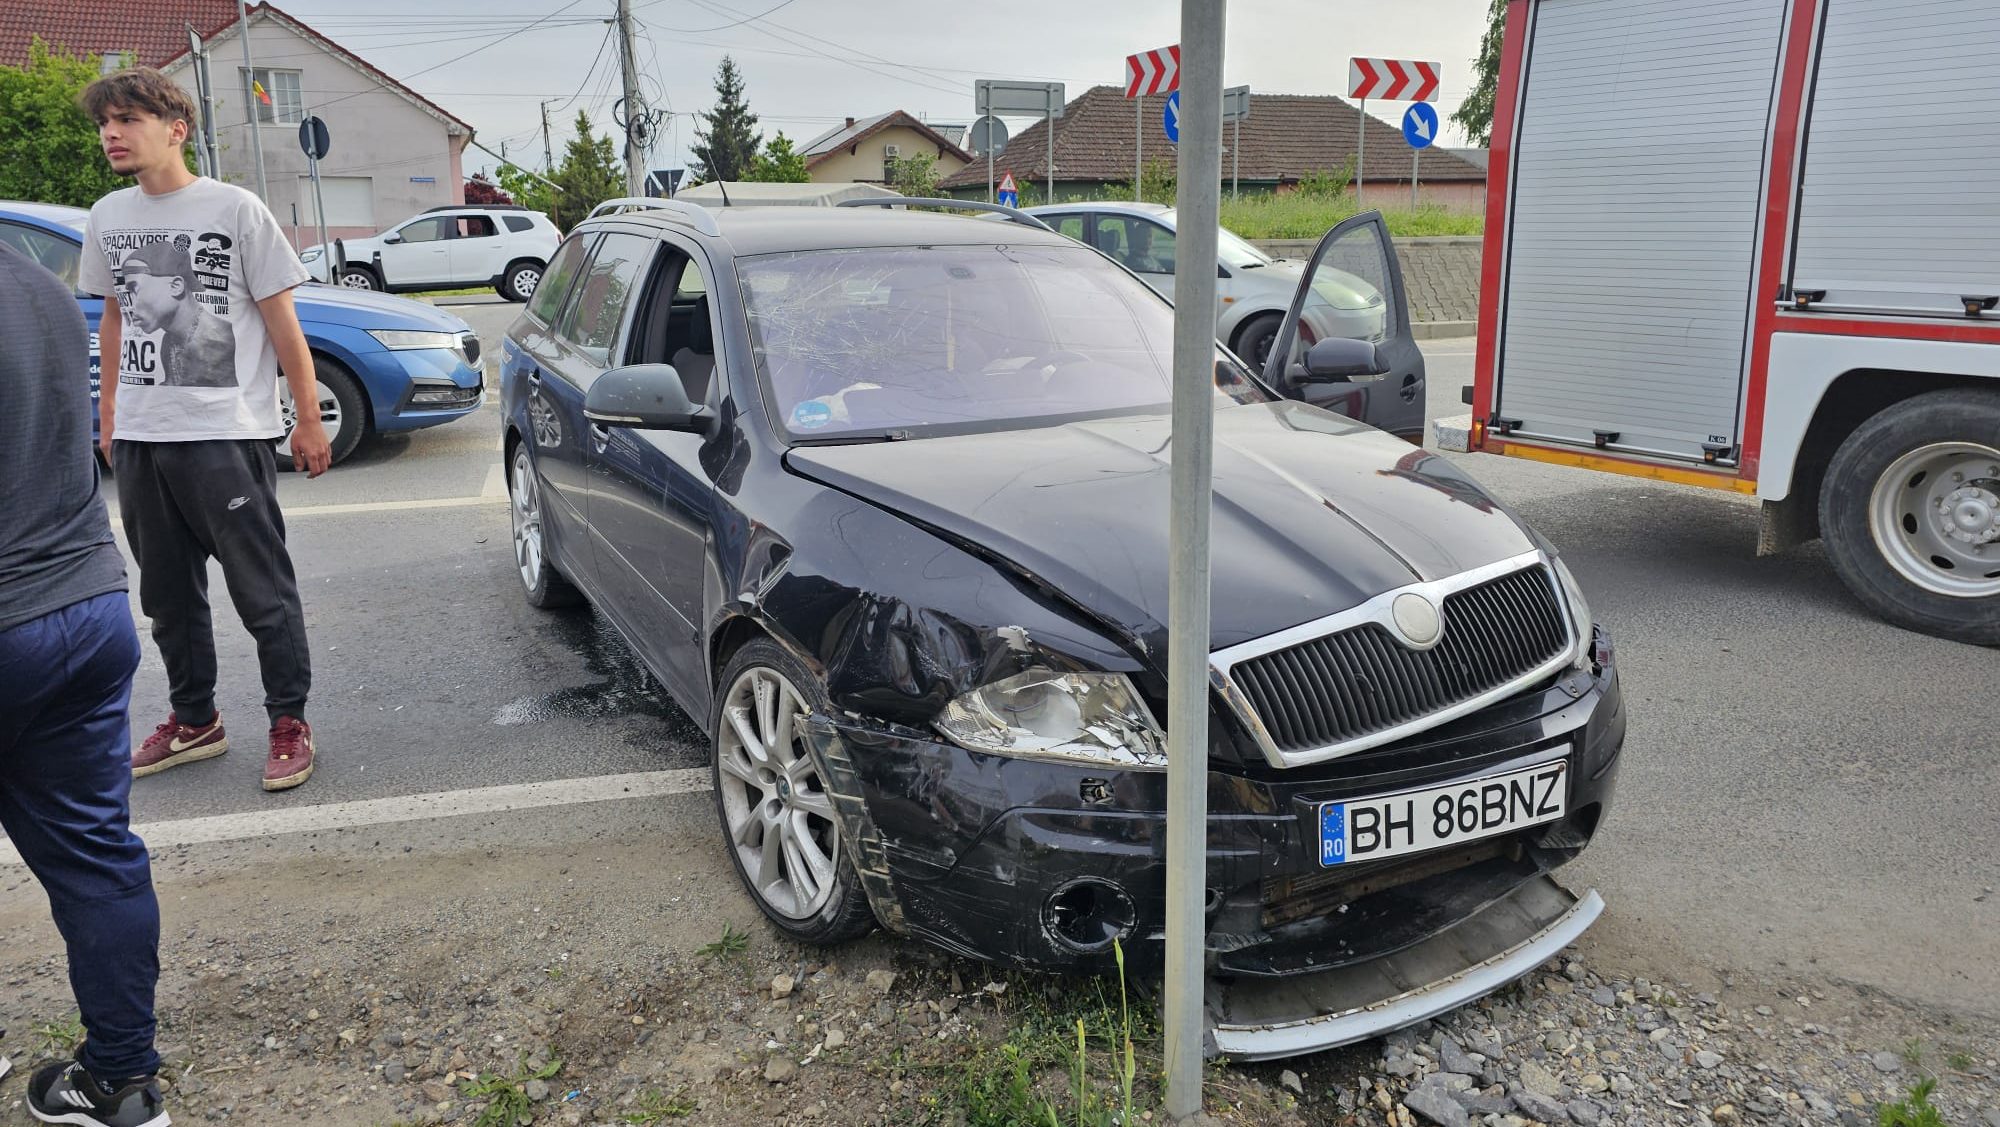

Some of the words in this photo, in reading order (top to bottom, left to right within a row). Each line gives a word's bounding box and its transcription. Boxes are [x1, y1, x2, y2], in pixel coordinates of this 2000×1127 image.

[194, 293, 229, 306] CALIFORNIA
[214, 304, 229, 315] LOVE
[1350, 800, 1414, 855] BH
[1323, 838, 1343, 858] RO
